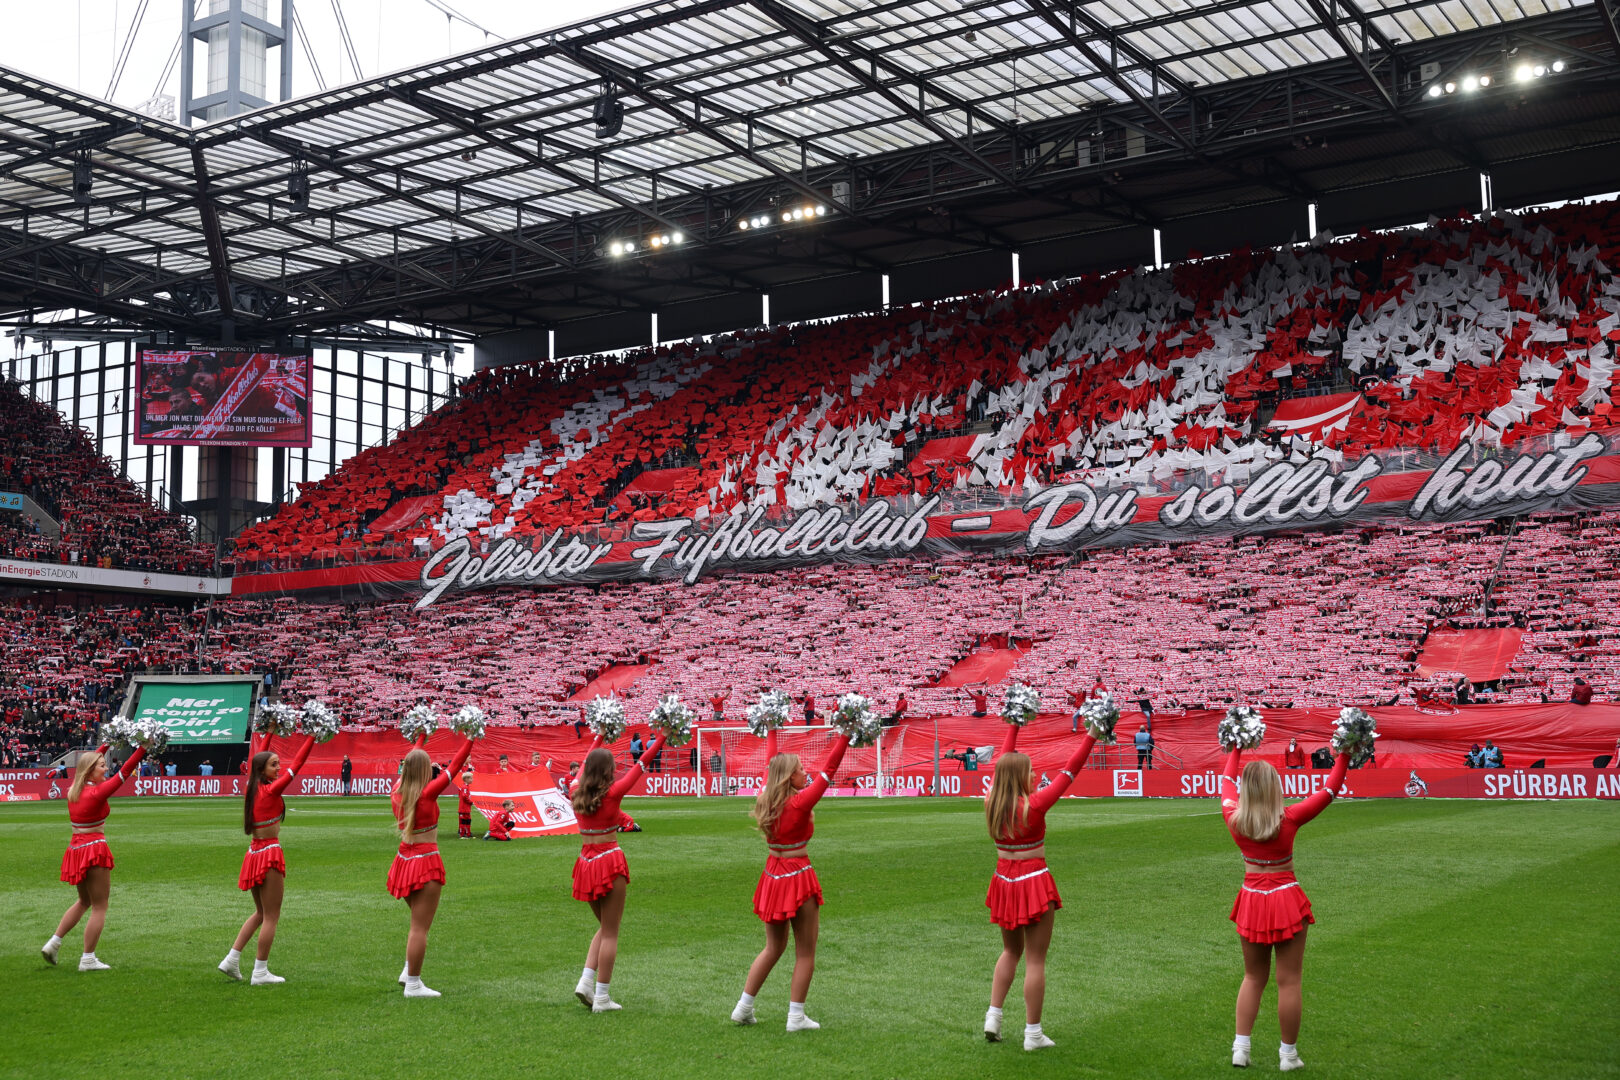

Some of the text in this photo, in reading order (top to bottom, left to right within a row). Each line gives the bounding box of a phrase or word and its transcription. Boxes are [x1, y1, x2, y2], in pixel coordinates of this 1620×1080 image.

[257, 416, 278, 424] DURCH
[415, 529, 612, 609] Geliebter
[630, 494, 941, 586] Fußballclub
[1025, 480, 1137, 554] Du
[1158, 454, 1384, 531] sollst
[1408, 432, 1605, 521] heut
[166, 697, 225, 708] Mer
[142, 706, 244, 716] stonn zo
[162, 716, 222, 727] Dir!
[134, 776, 196, 794] SPÜRBAR
[646, 774, 706, 794] SPÜRBAR
[1484, 769, 1588, 796] SPÜRBAR
